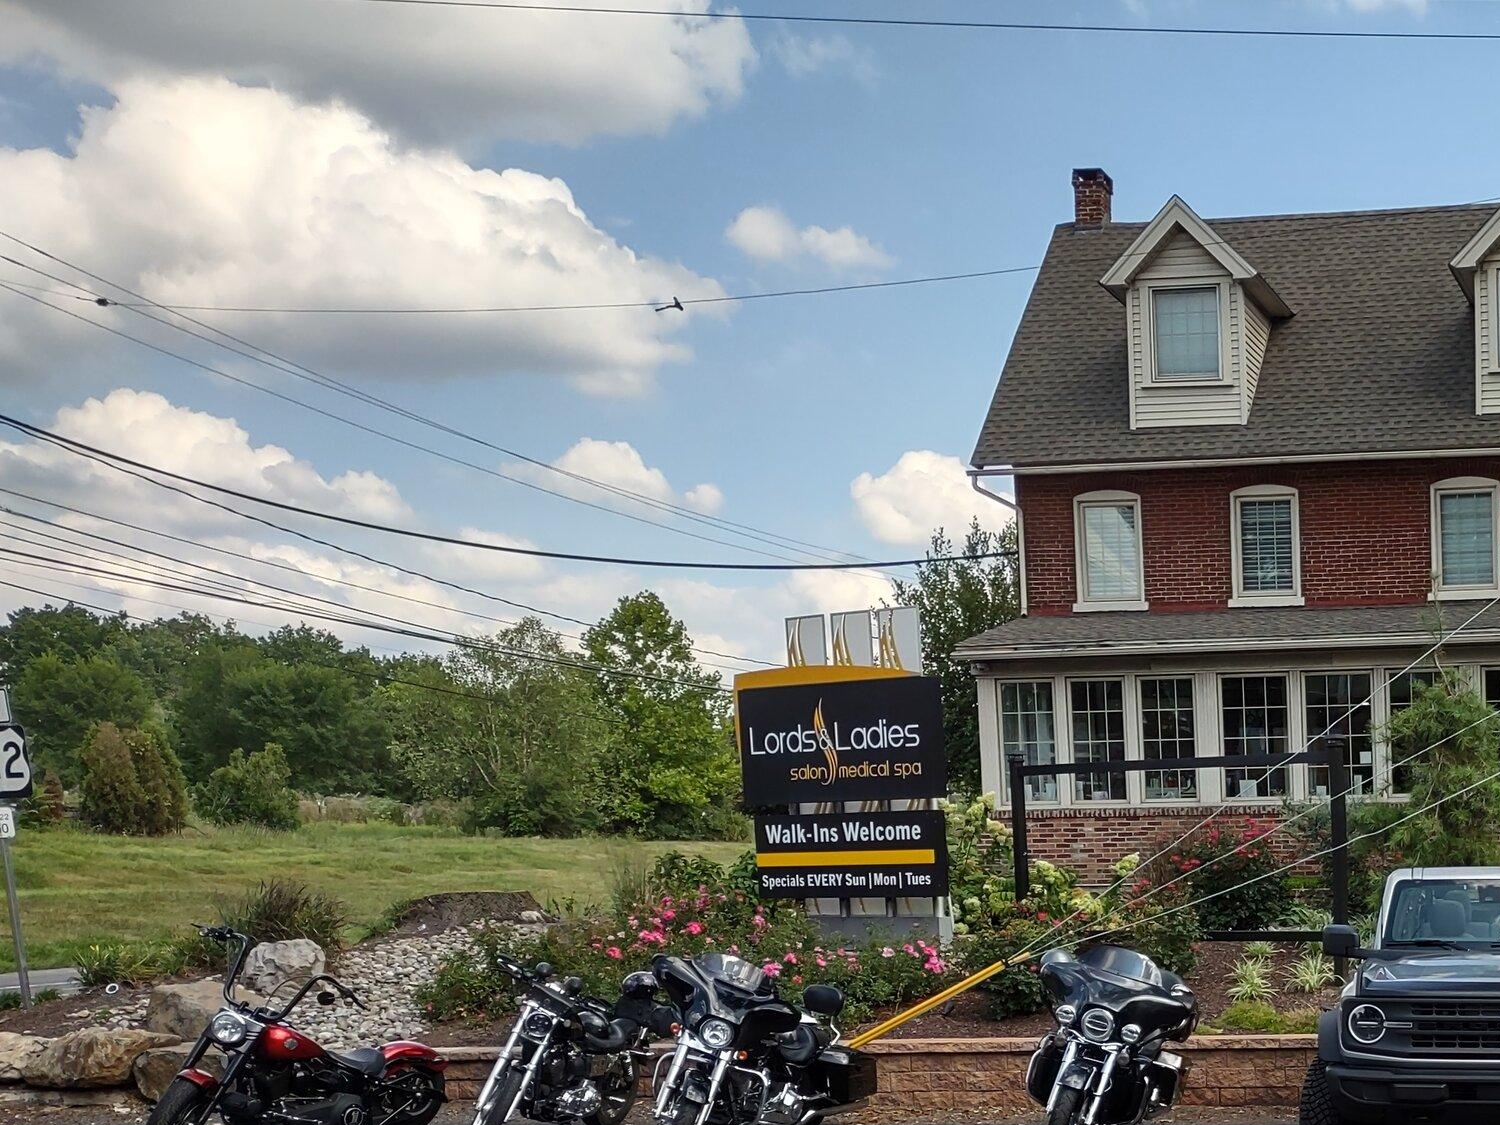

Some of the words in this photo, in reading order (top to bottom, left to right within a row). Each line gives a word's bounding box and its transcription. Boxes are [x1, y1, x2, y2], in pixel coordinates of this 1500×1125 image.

[749, 724, 817, 755] Lords
[818, 728, 834, 750] &
[834, 719, 920, 751] Ladies
[790, 764, 828, 781] salon
[838, 760, 889, 778] medical
[894, 762, 922, 779] spa
[765, 823, 839, 844] Walk-Ins
[842, 821, 921, 842] Welcome
[762, 874, 805, 890] Specials
[807, 873, 843, 887] EVERY
[845, 873, 866, 886] Sun
[873, 872, 897, 886] Mon
[905, 872, 931, 886] Tues
